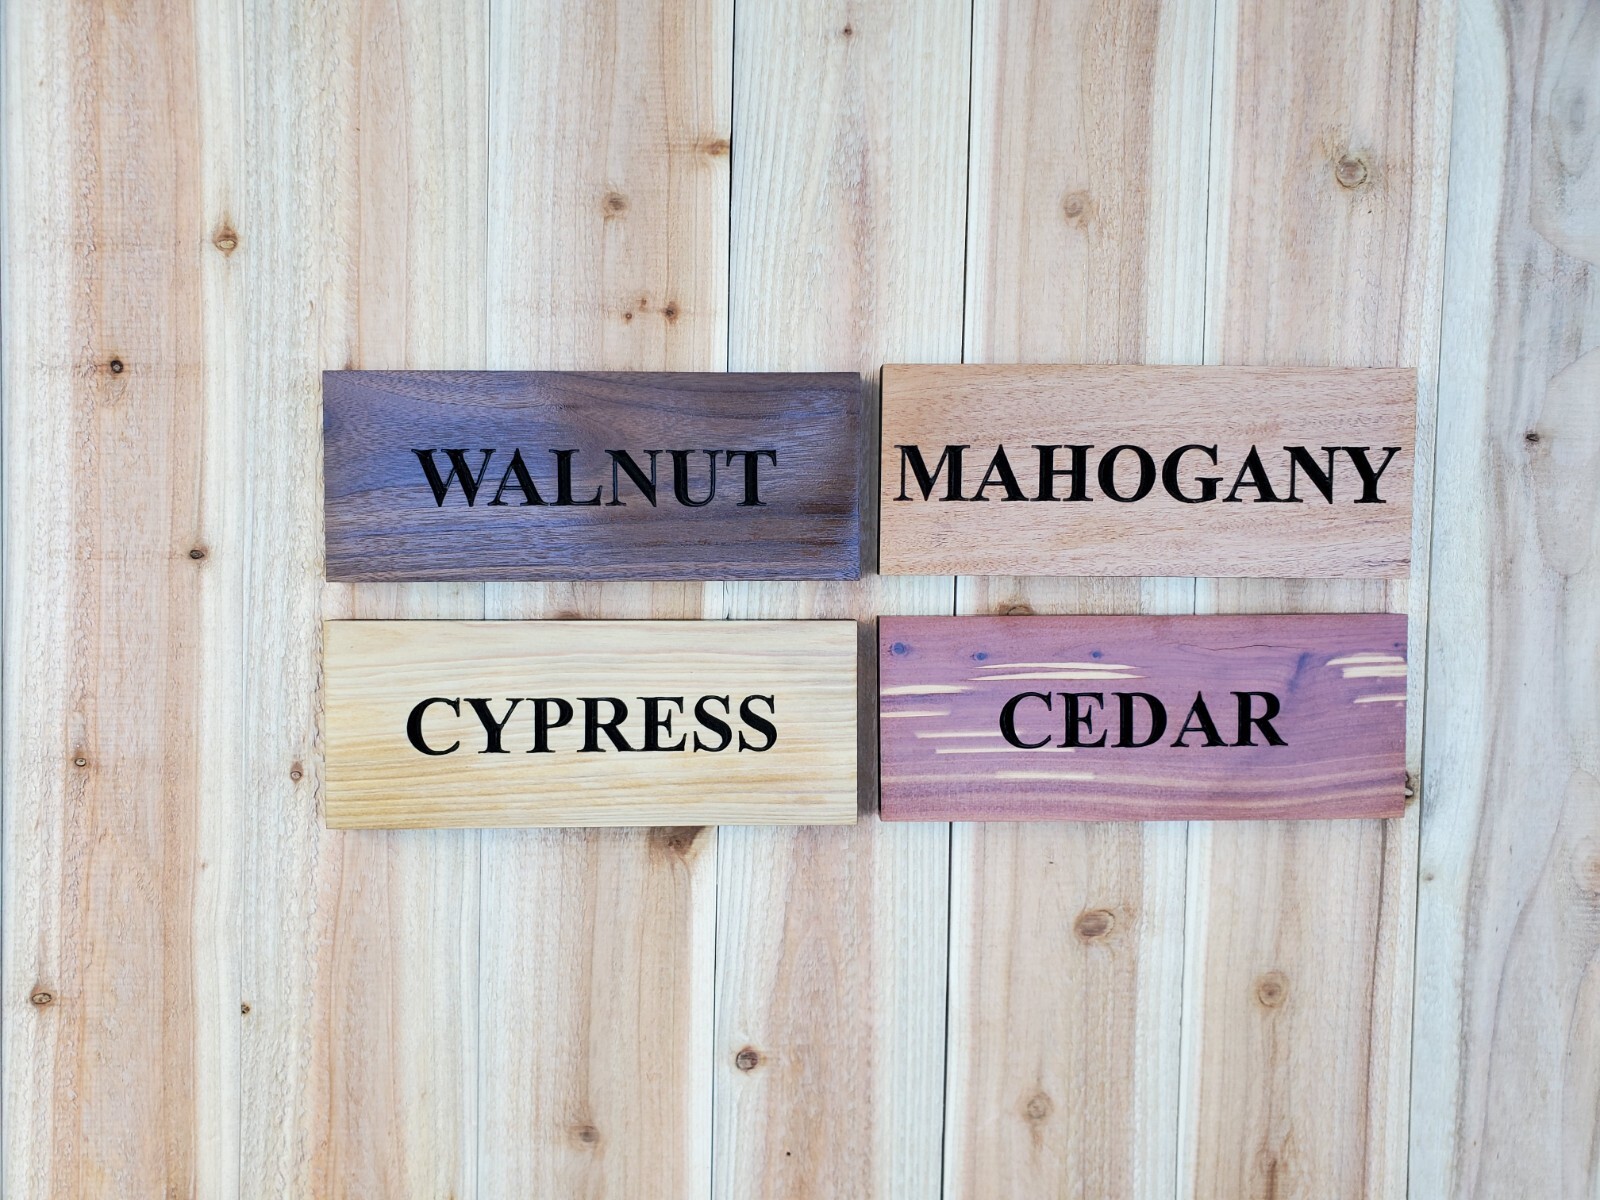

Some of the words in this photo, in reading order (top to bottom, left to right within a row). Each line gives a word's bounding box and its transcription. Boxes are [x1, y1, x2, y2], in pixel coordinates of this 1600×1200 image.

[411, 448, 777, 507] WALNUT
[893, 444, 1402, 504] MAHOGANY
[406, 694, 777, 755] CYPRESS
[1000, 691, 1289, 748] CEDAR
